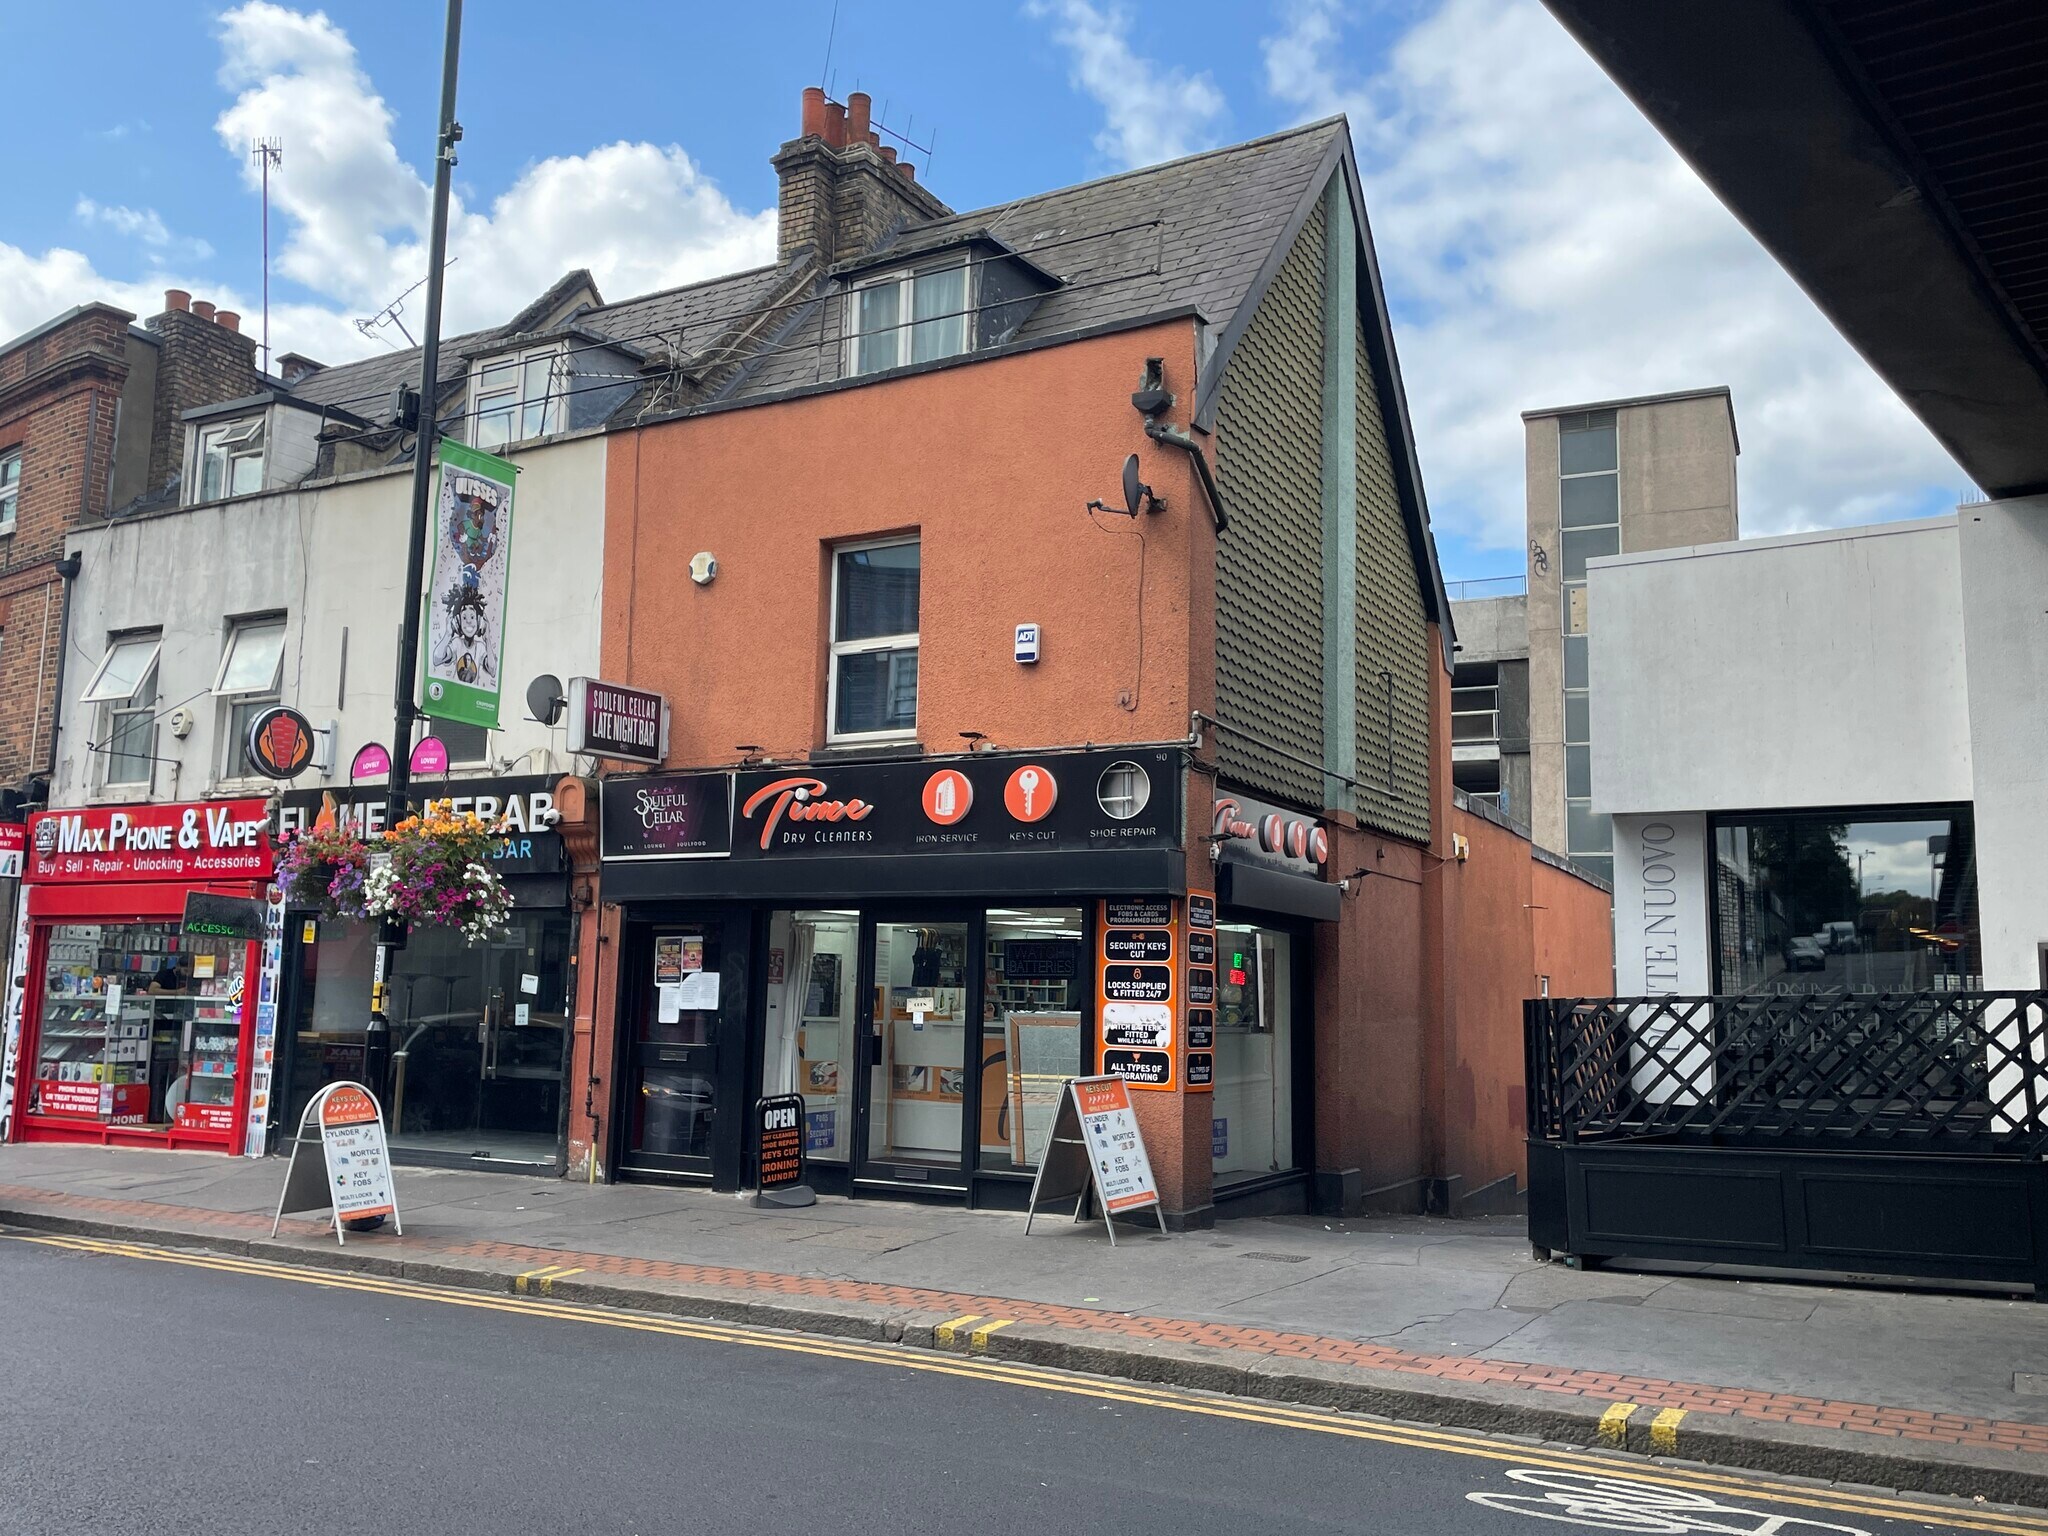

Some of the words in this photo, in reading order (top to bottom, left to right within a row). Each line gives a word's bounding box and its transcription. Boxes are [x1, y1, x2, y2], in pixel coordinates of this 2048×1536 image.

[455, 477, 497, 507] ULYSSES
[1018, 631, 1035, 641] ADT
[594, 690, 626, 714] SOULFUL
[629, 697, 656, 719] CELLAR
[593, 711, 612, 740] LATE
[613, 714, 638, 744] NIGHT
[638, 720, 654, 747] BAR
[1156, 754, 1168, 762] 90
[363, 761, 379, 770] LOVELY
[633, 789, 688, 812] SOULFUL
[742, 777, 874, 850] Time
[642, 811, 685, 828] CELLAR
[5, 828, 22, 838] VAPE
[58, 815, 107, 853] MAX
[108, 813, 172, 851] PHONE
[179, 808, 199, 849] &
[206, 807, 257, 848] VAPE
[1090, 829, 1117, 838] SHOE
[1120, 827, 1156, 837] REPAIR
[783, 832, 806, 844] DRY
[815, 831, 872, 842] CLEANERS
[916, 834, 938, 843] IRON
[940, 834, 978, 843] SERVICE
[1009, 832, 1034, 840] KEYS
[1037, 831, 1056, 840] CUT
[38, 861, 56, 875] Buy
[65, 860, 83, 873] Sell
[93, 860, 123, 874] Repair
[133, 857, 183, 872] Unlocking
[194, 855, 260, 869] Accessories
[1642, 822, 1677, 937] NUOVO
[1110, 942, 1146, 950] SECURITY
[1015, 946, 1065, 959] WATCH
[1010, 960, 1072, 973] BATTERIES
[1108, 981, 1130, 989] LOCKS
[1132, 982, 1166, 990] SUPPLIED
[1146, 990, 1161, 998] 24/7
[1111, 1063, 1125, 1071] ALL
[1127, 1064, 1150, 1072] TYPES
[1152, 1065, 1162, 1073] OF
[77, 1086, 98, 1094] REPAIRS
[1085, 1084, 1100, 1093] KEYS
[1101, 1083, 1113, 1091] CUT
[71, 1095, 98, 1104] YOURSELF
[332, 1095, 348, 1103] KEYS
[325, 1114, 345, 1122] WHILE
[358, 1112, 372, 1120] WAIT
[765, 1108, 796, 1130] OPEN
[816, 1114, 828, 1122] FOBS
[1085, 1114, 1110, 1124] CYLINDER
[325, 1128, 360, 1138] CYLINDER
[772, 1131, 798, 1139] CLEANERS
[810, 1129, 834, 1138] SECURITY
[1112, 1131, 1136, 1142] MORTICE
[763, 1141, 777, 1149] SHOE
[778, 1139, 799, 1147] REPAIR
[815, 1138, 828, 1146] KEYS
[350, 1148, 380, 1157] MORTICE
[762, 1151, 782, 1160] KEYS
[784, 1148, 799, 1156] CUT
[762, 1159, 799, 1173] IRONING
[1115, 1164, 1129, 1173] FOBS
[354, 1171, 368, 1179] KEY
[762, 1170, 798, 1184] LAUNDRY
[353, 1179, 372, 1187] FOBS
[339, 1201, 362, 1209] SECURITY
